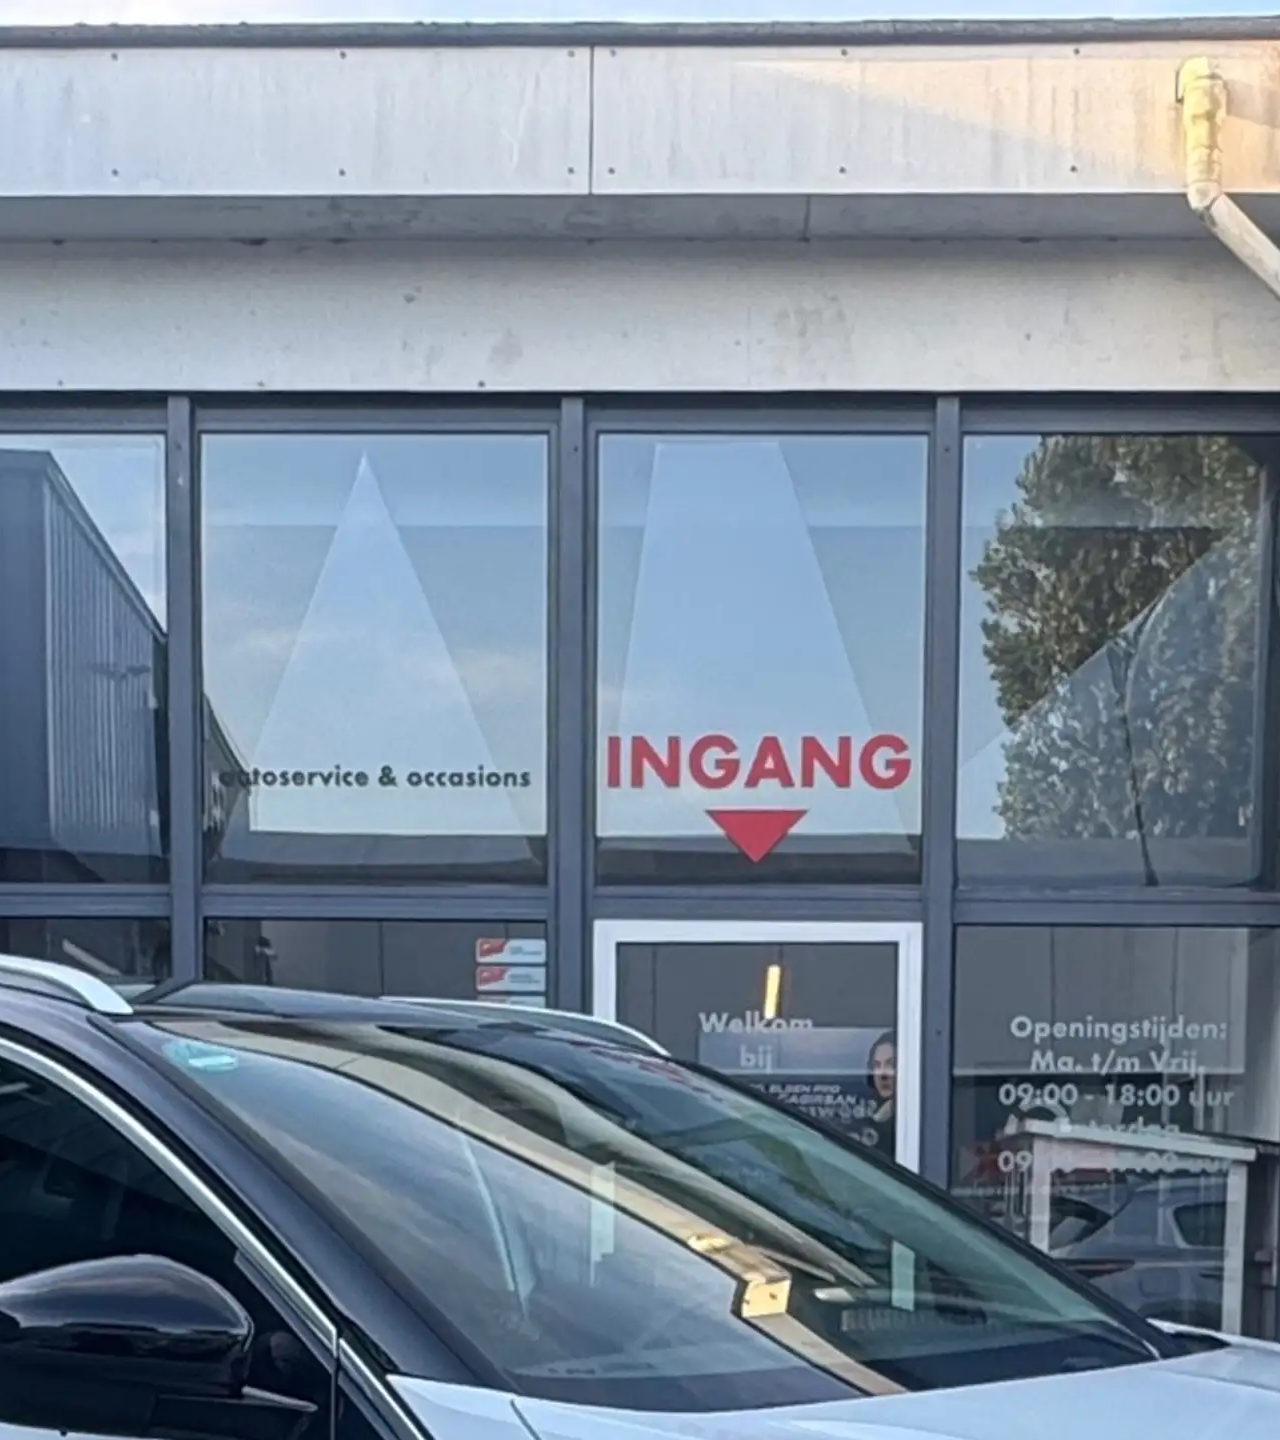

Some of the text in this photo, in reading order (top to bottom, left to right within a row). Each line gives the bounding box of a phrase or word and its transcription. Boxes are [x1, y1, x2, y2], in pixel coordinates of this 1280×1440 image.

[607, 734, 912, 790] INGANG
[219, 764, 532, 788] autoservice & occasions
[698, 1010, 814, 1034] Welkom
[1010, 1015, 1228, 1045] Openingstijden:
[739, 1045, 773, 1075] bij
[1029, 1050, 1083, 1073] Ma.
[1090, 1049, 1140, 1076] t/m
[998, 1083, 1079, 1106] 09:00
[1104, 1083, 1181, 1107] 18:00
